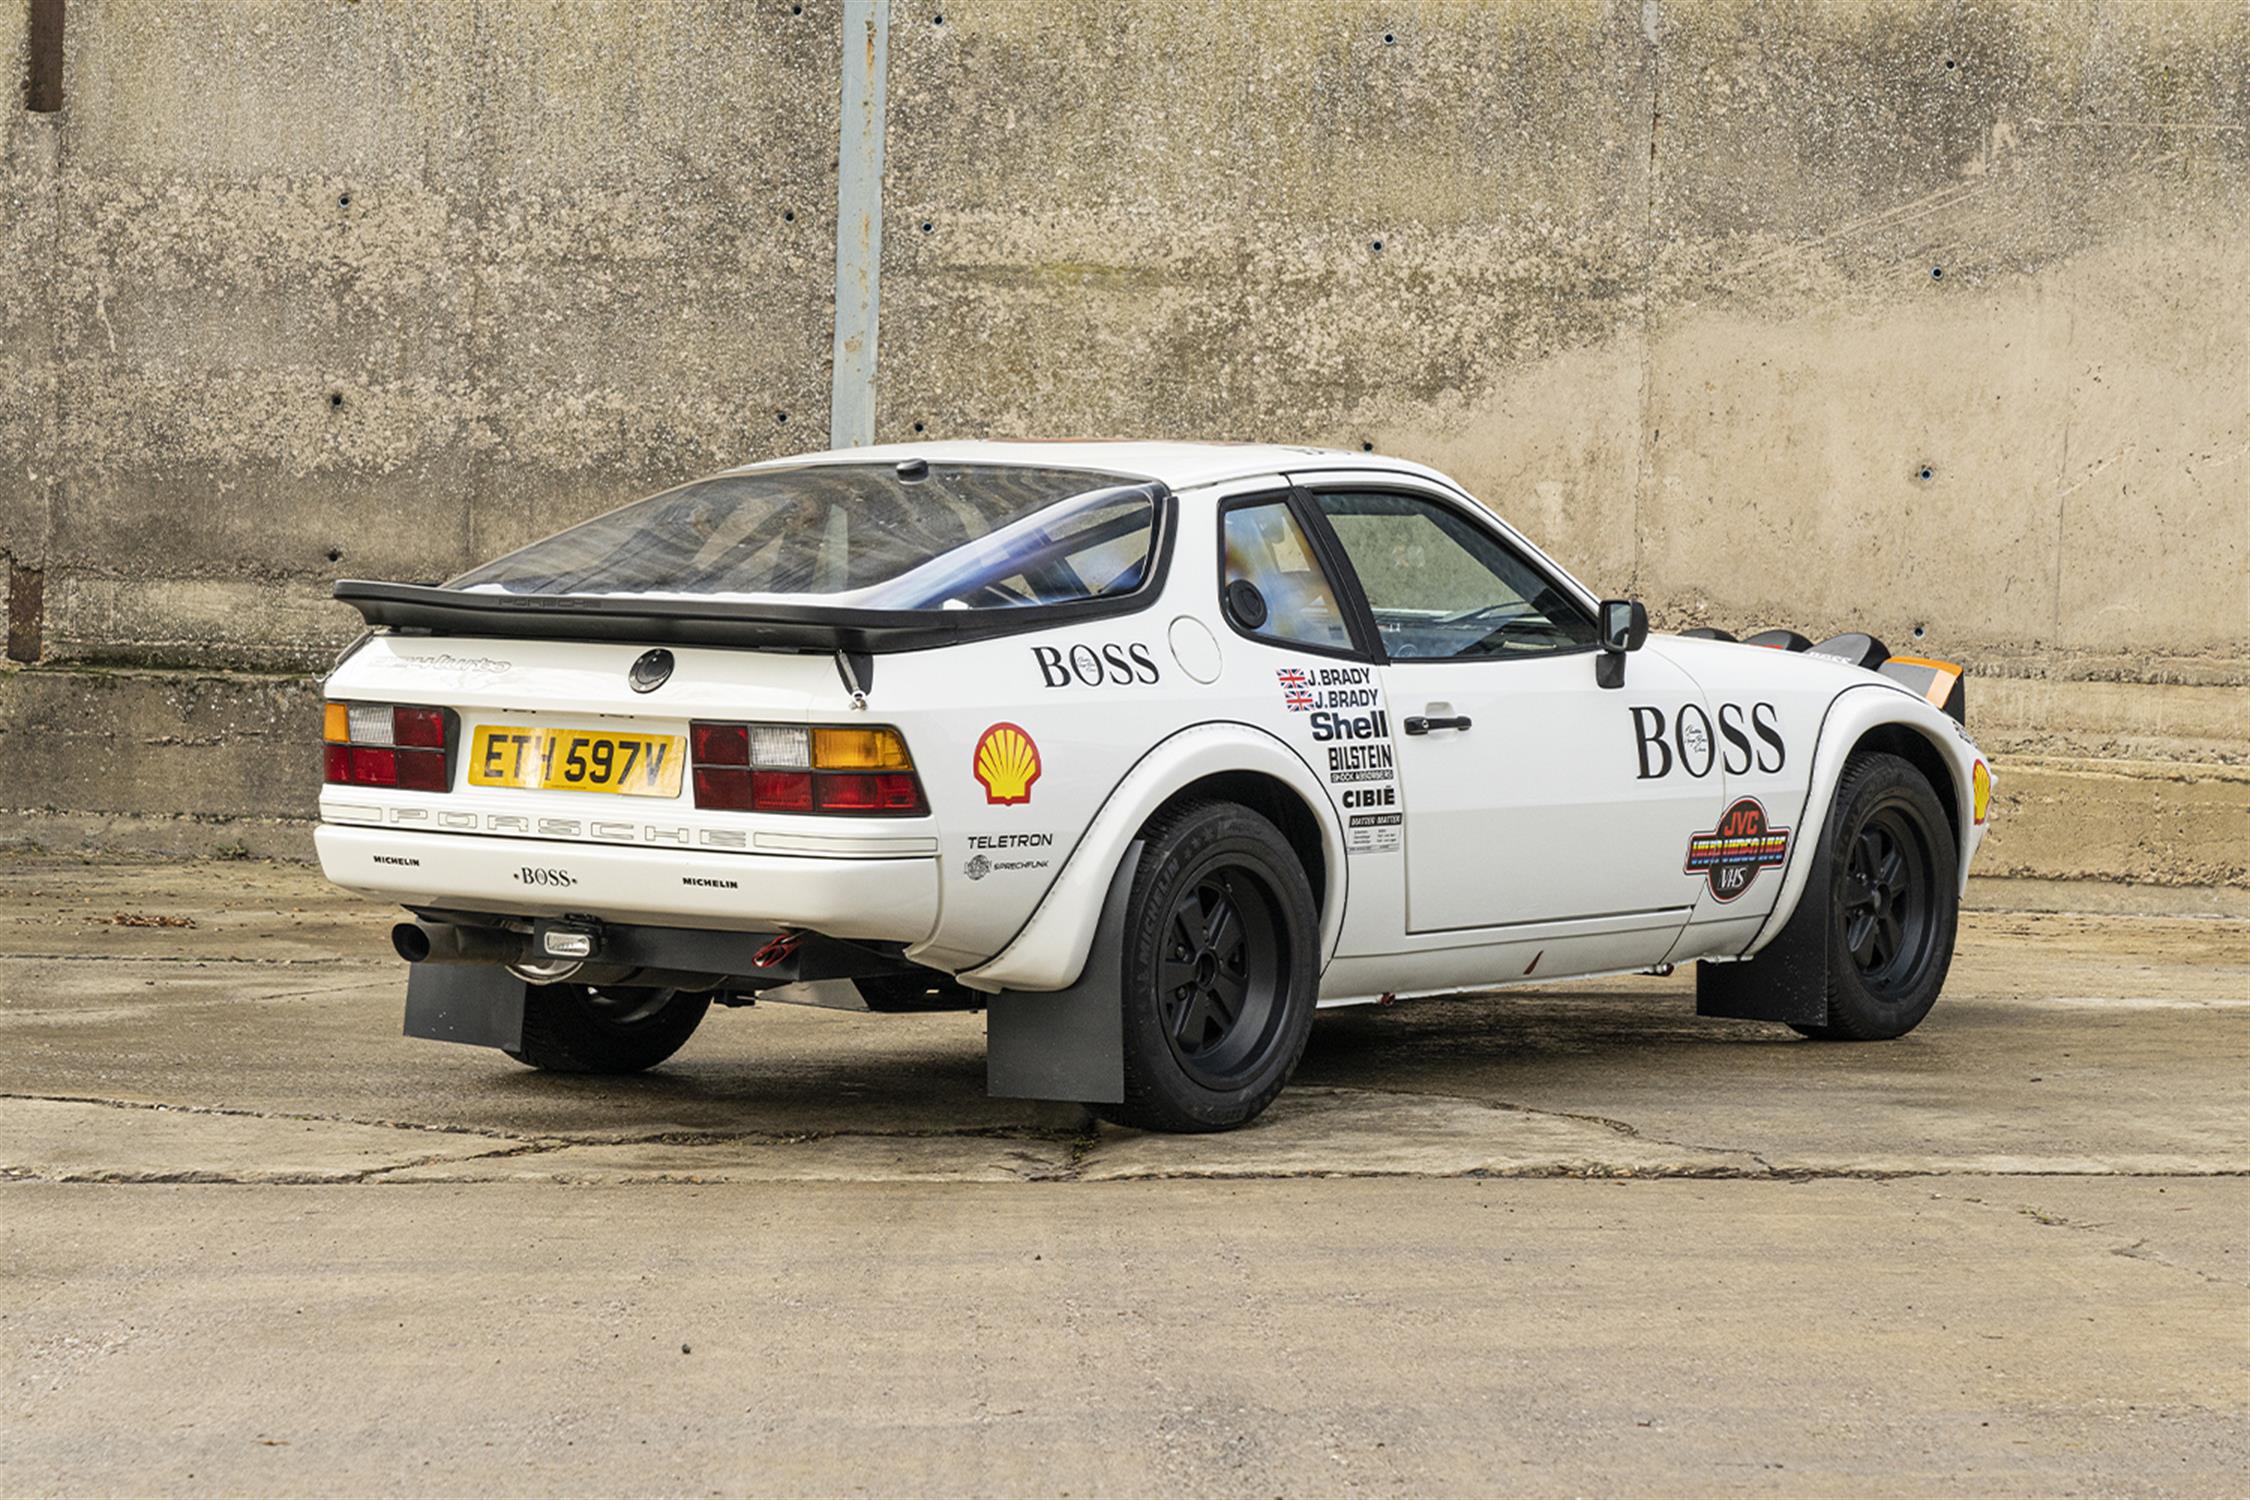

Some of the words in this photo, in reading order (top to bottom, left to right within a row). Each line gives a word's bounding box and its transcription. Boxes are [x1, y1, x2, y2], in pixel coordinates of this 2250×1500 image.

[1030, 642, 1160, 688] BOSS
[1310, 710, 1389, 742] Shell
[1628, 702, 1786, 780] BOSS
[484, 734, 557, 781] ETH
[564, 738, 668, 786] 597V
[1328, 743, 1393, 771] BILSTEIN
[389, 807, 746, 848] PORSCHE
[1723, 810, 1760, 837] JVC
[968, 833, 1053, 849] TELETRON
[373, 855, 420, 867] MICHELIN
[683, 877, 738, 889] MICHELIN
[1719, 866, 1747, 889] VHS
